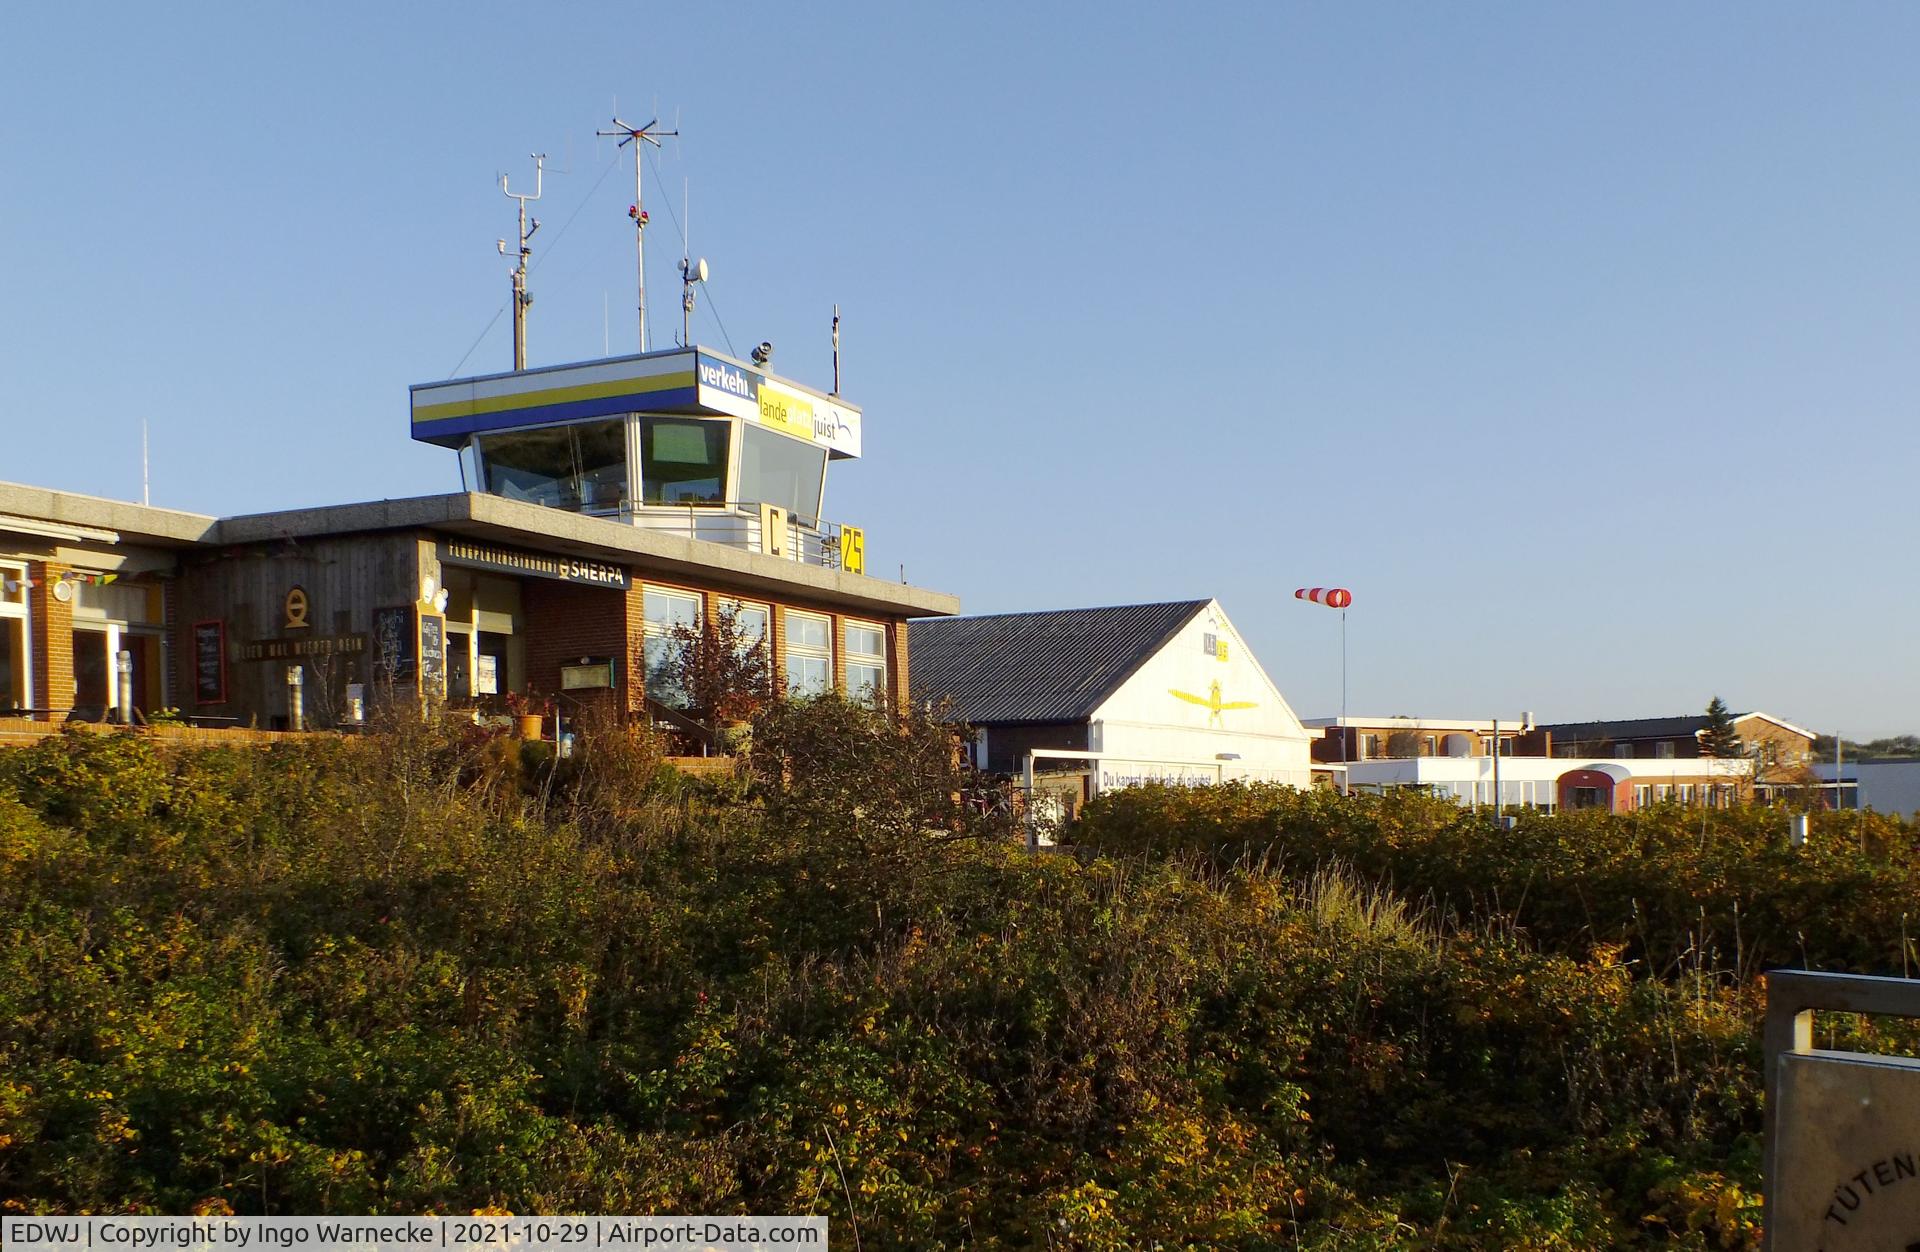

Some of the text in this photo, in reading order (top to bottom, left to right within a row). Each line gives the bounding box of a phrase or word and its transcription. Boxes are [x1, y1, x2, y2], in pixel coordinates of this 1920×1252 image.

[813, 414, 836, 440] juist
[770, 508, 780, 556] C
[843, 528, 862, 574] 25
[570, 561, 624, 585] SHERPA
[1103, 771, 1114, 787] Du
